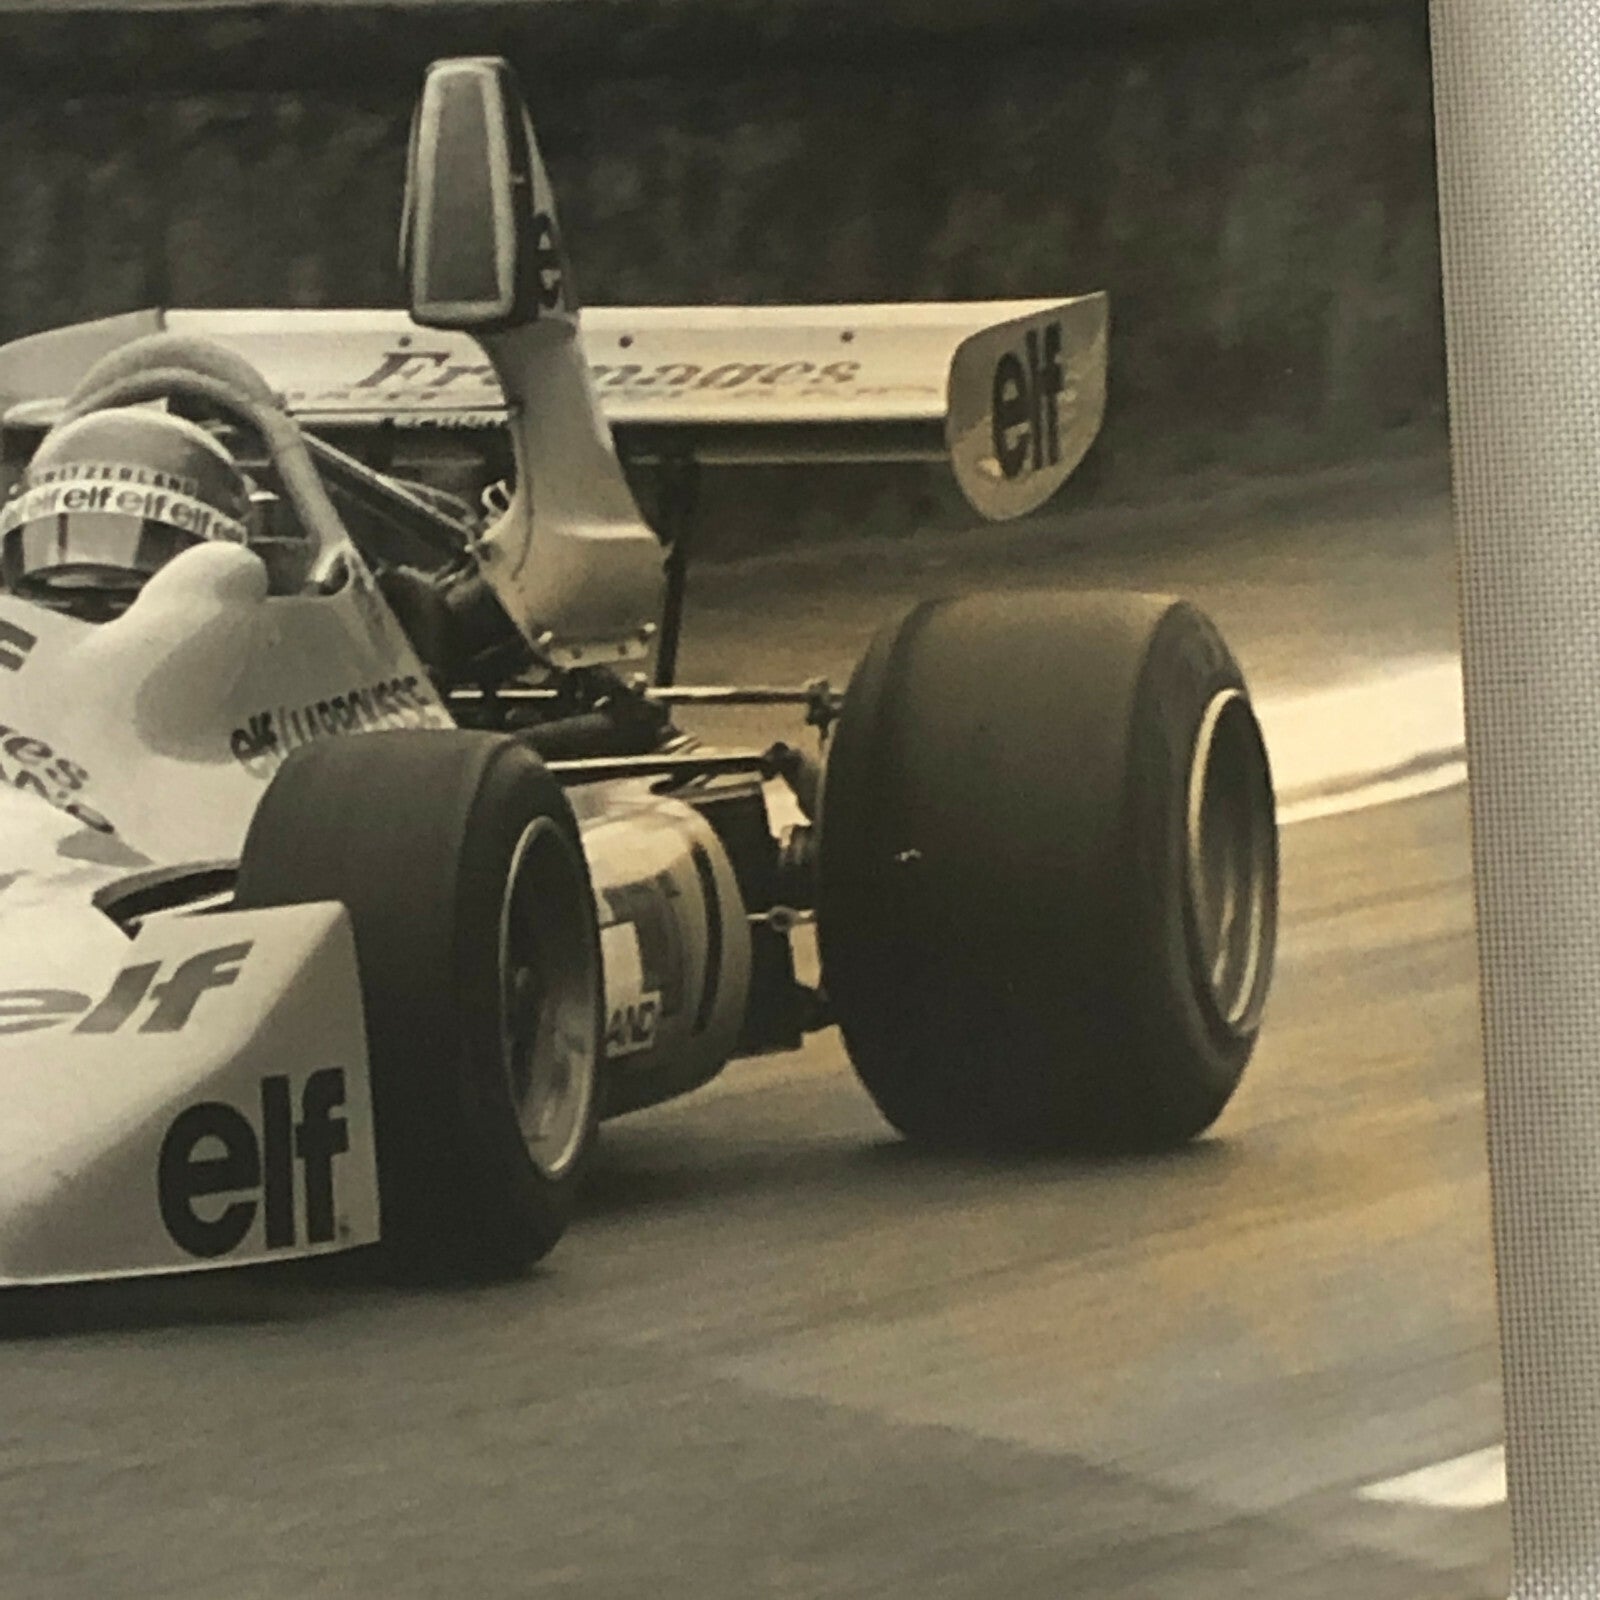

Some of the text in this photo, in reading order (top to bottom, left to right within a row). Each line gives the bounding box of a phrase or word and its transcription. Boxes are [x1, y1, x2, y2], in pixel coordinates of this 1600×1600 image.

[993, 320, 1065, 481] elf
[63, 485, 113, 510] elf
[116, 490, 169, 521] elf
[157, 1066, 349, 1259] elf
